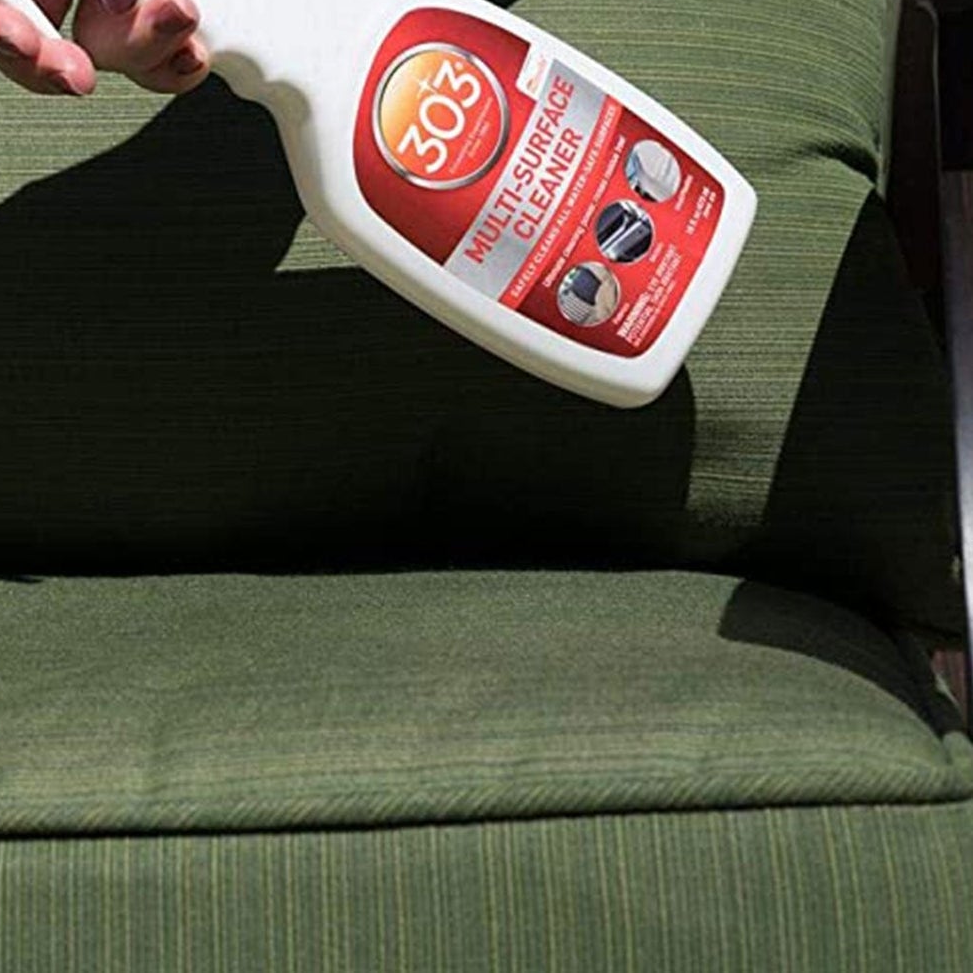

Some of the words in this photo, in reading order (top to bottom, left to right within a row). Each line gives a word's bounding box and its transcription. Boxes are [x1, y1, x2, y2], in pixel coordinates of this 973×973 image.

[398, 59, 482, 173] 303
[463, 75, 574, 263] MULTI-SURFACE
[512, 127, 583, 240] CLEANER
[510, 262, 537, 298] SAFELY
[532, 225, 560, 264] CLEANS
[555, 206, 571, 226] ALL
[566, 147, 600, 207] WATER-SAFE
[594, 104, 617, 148] SURFACES
